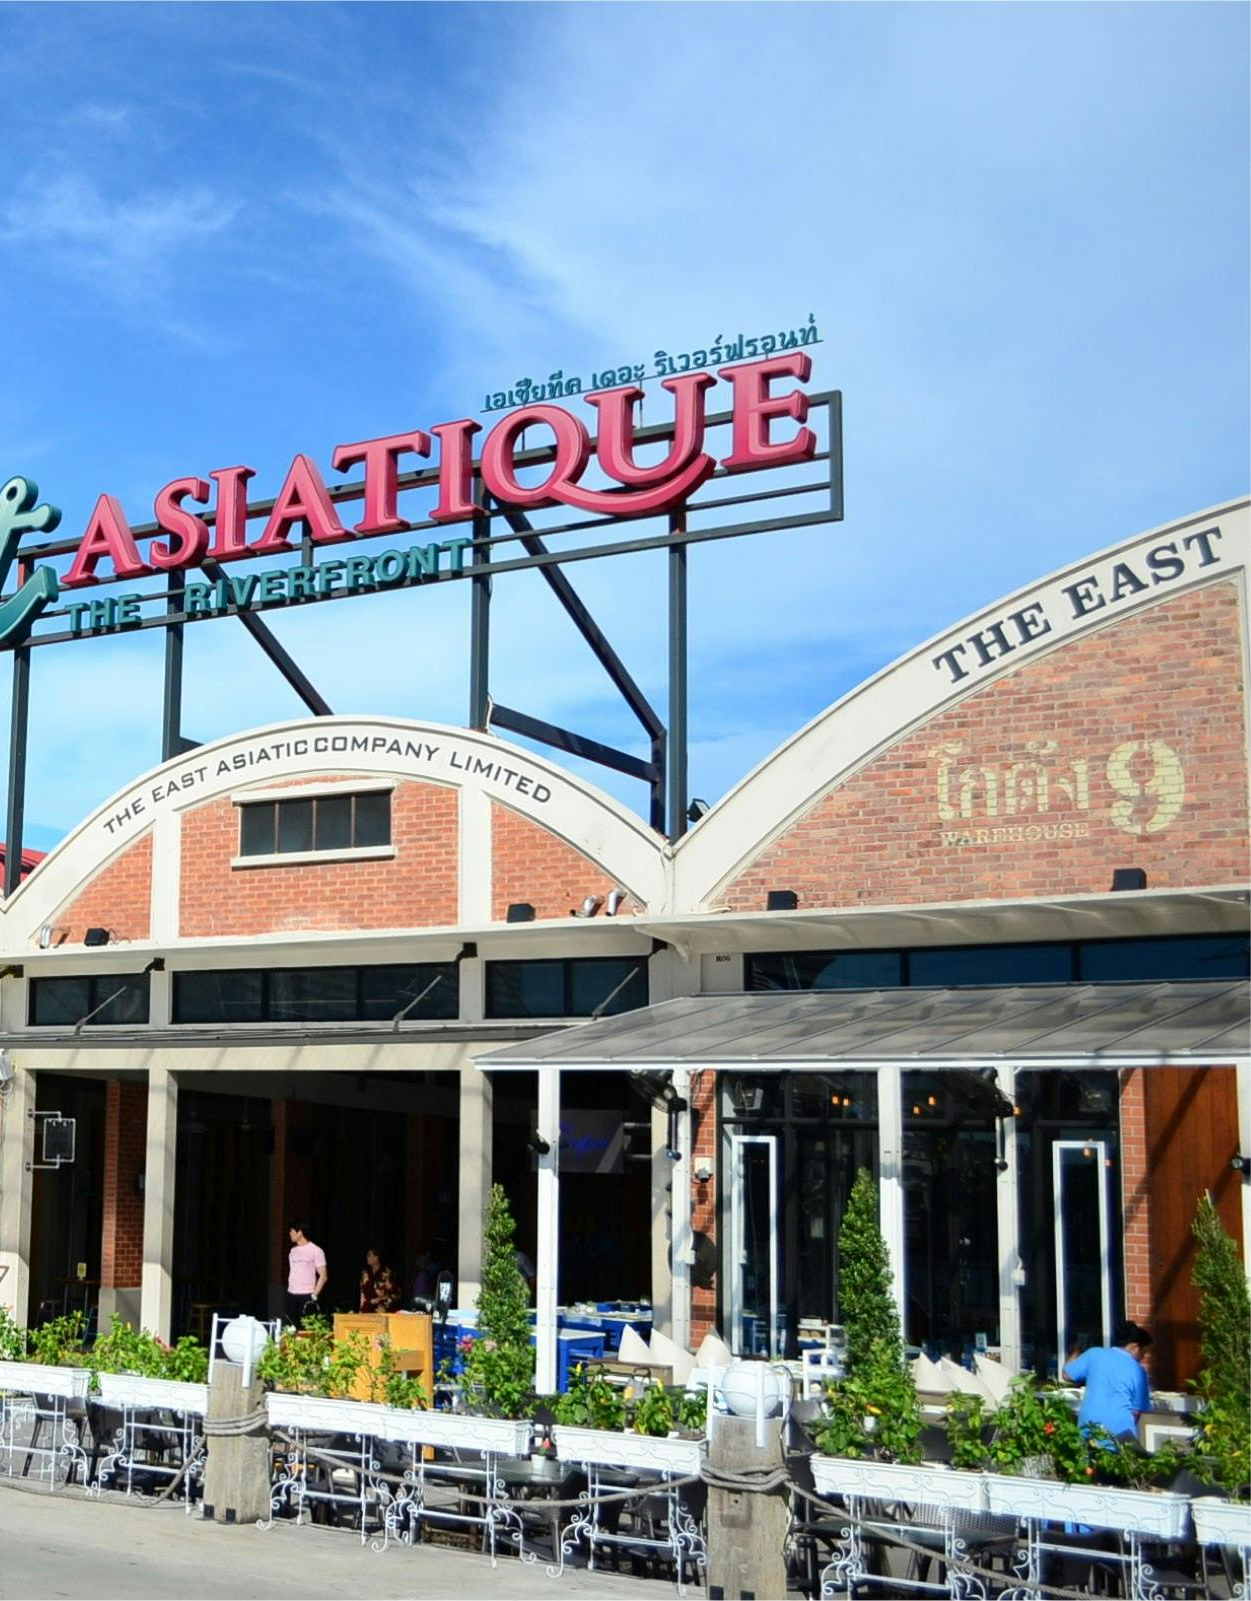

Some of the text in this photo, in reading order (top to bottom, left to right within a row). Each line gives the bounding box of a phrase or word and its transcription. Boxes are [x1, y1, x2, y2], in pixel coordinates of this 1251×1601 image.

[591, 362, 646, 391] เดอะ
[61, 350, 817, 586] ASIATIQUE
[64, 537, 473, 635] THE RIVERFRONT
[931, 525, 1223, 685] THE EAST
[103, 735, 552, 835] THE EAST ASIATIC COMPANY LIMITED
[1106, 739, 1186, 835] 9
[940, 822, 1091, 847] WAREHOUSE
